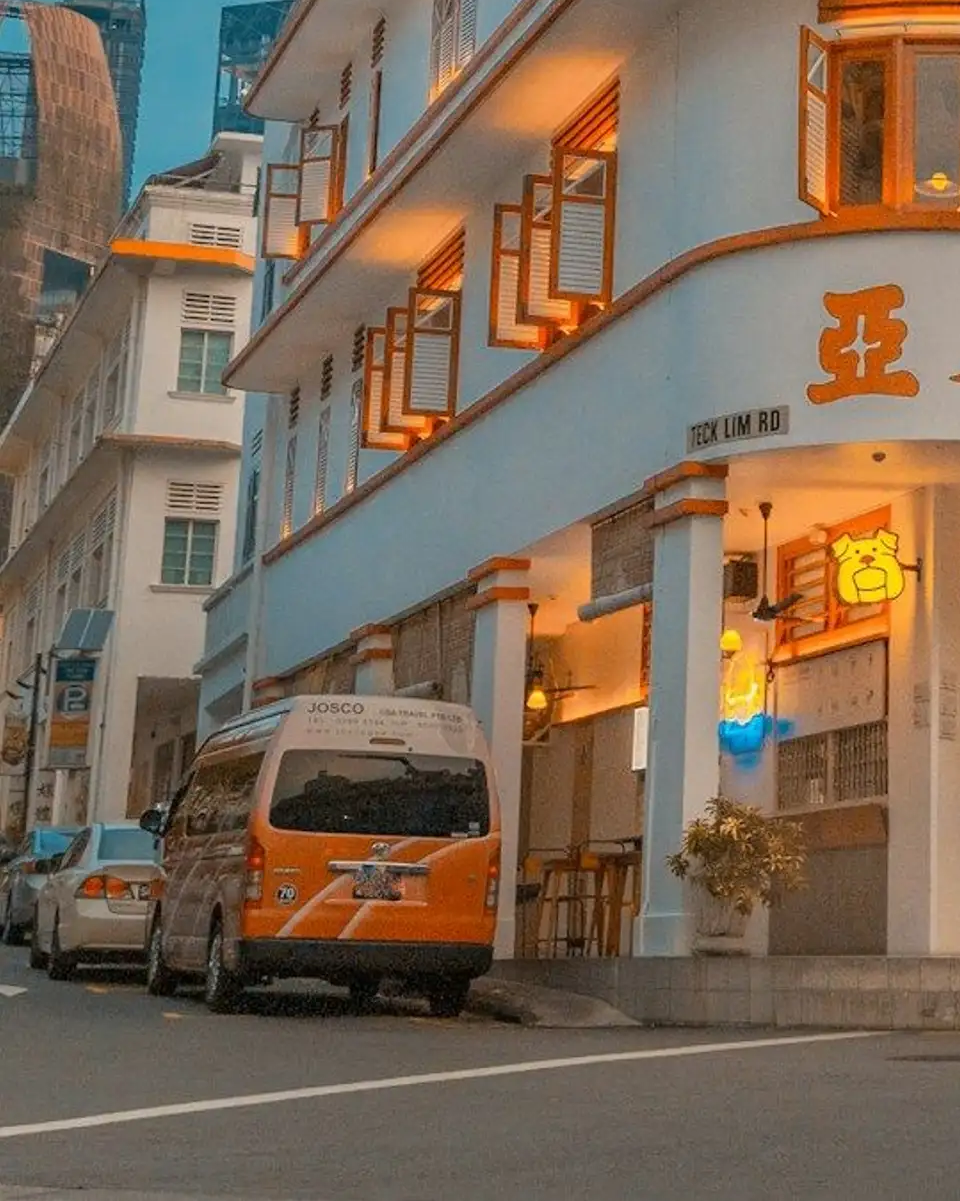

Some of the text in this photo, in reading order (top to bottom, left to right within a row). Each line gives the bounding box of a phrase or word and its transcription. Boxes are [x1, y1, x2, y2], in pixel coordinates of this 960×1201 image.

[690, 410, 781, 447] TECK LIM RD
[307, 702, 364, 715] JOSCO
[279, 887, 294, 898] 70
